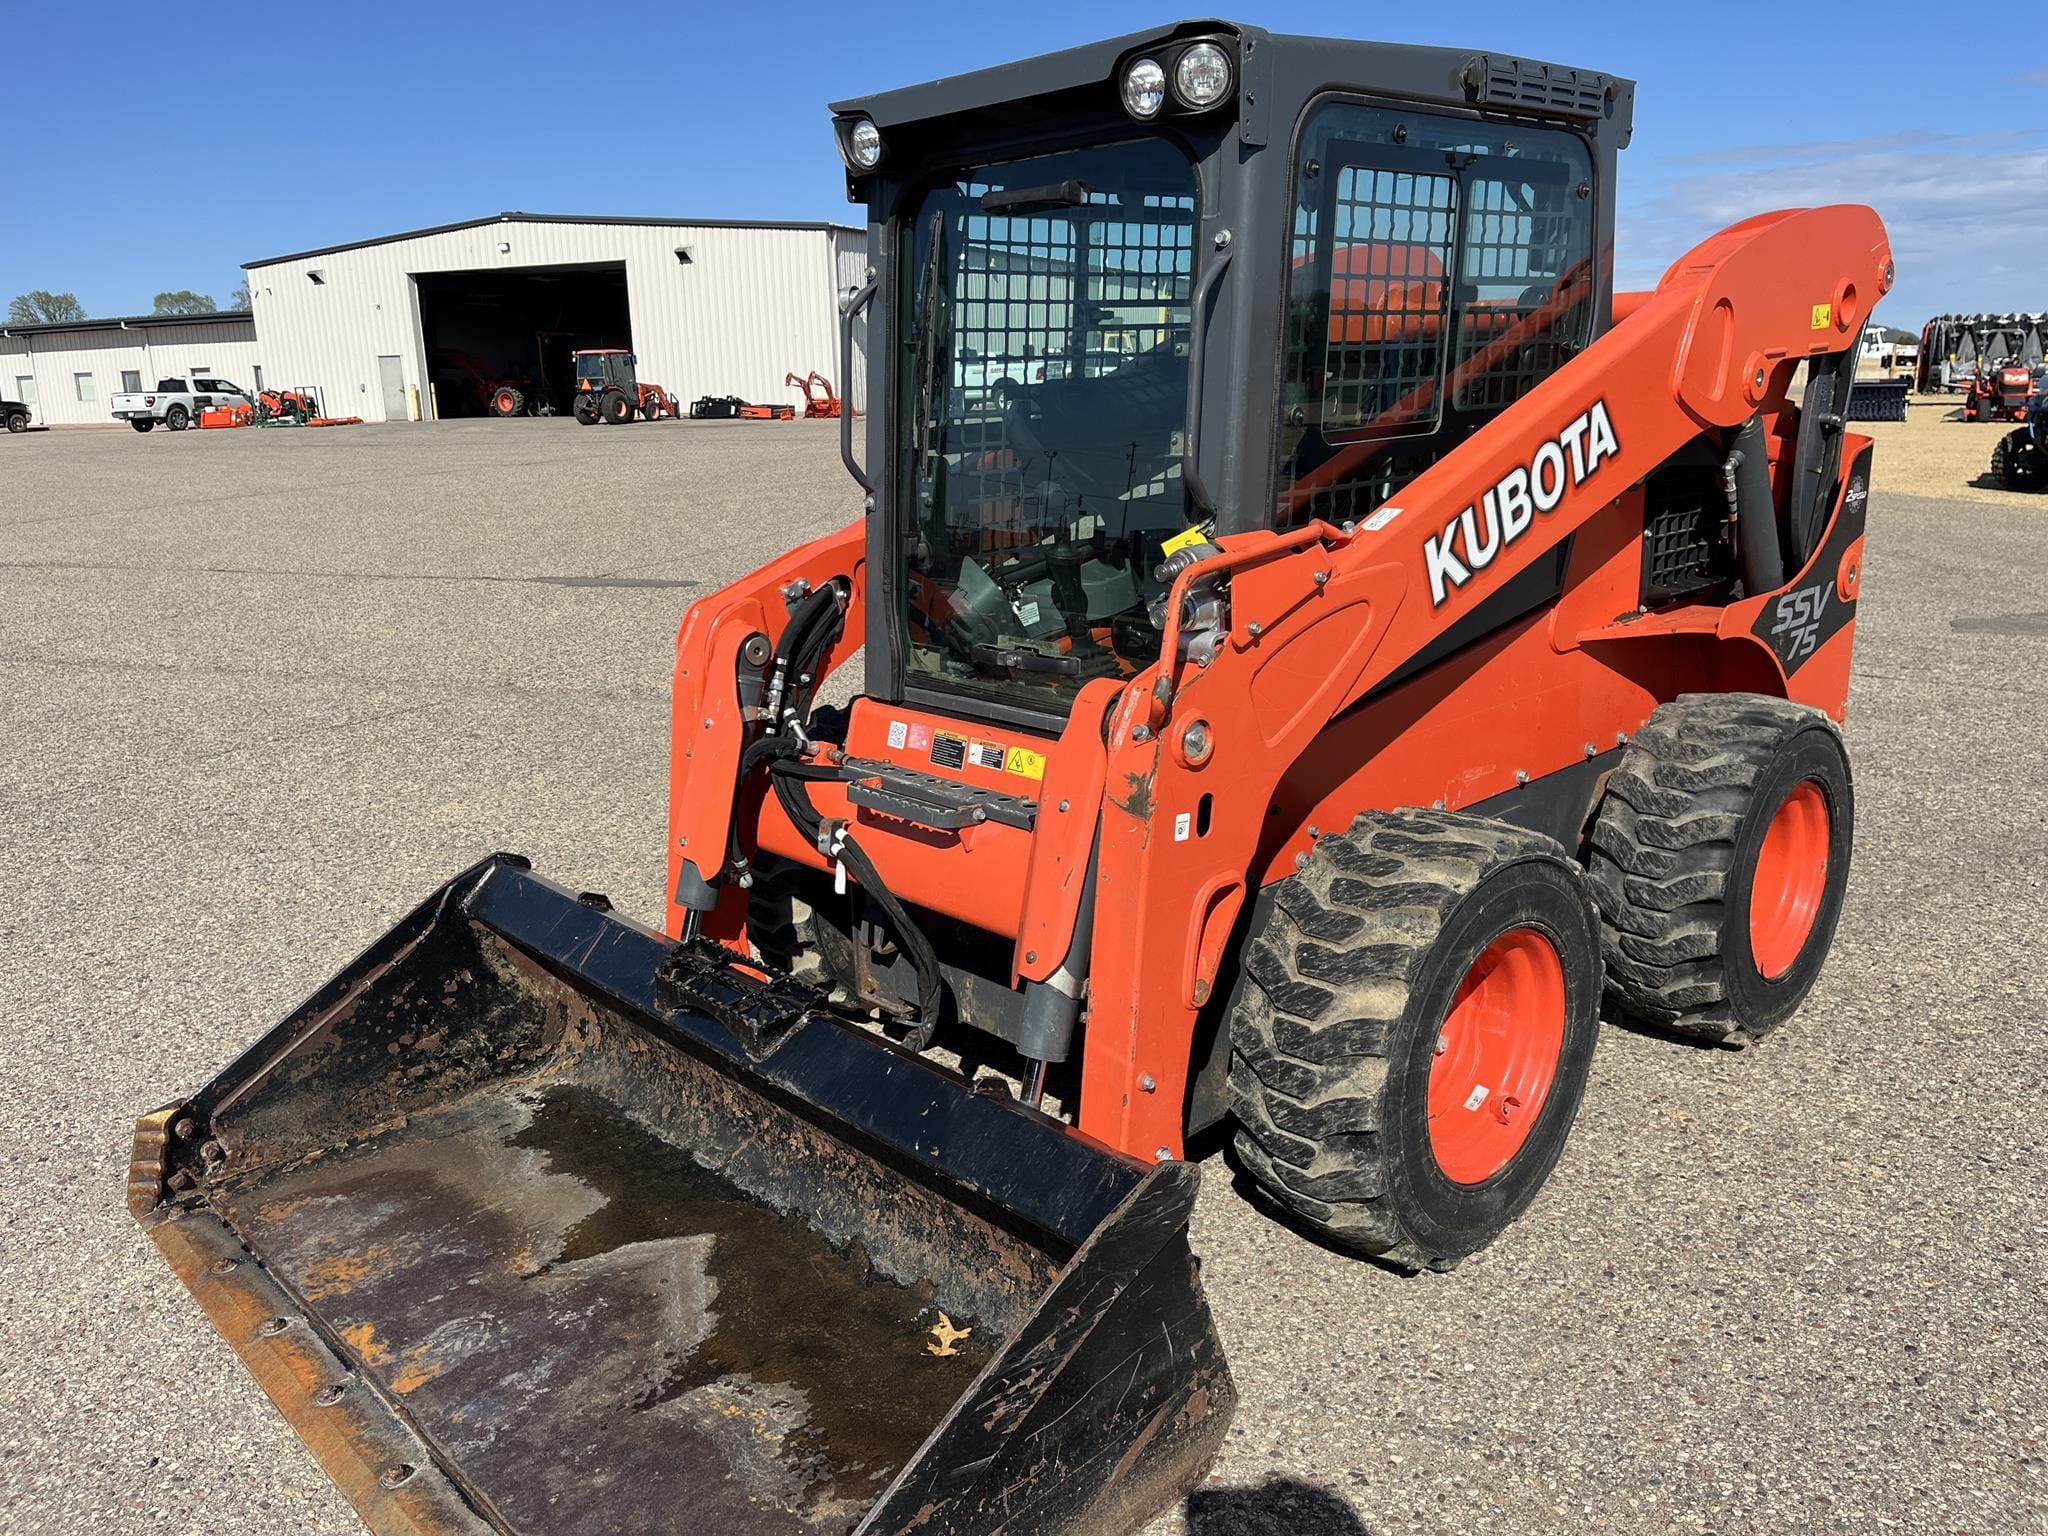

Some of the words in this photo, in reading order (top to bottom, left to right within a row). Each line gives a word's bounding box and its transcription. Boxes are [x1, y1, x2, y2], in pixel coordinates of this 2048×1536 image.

[1423, 400, 1619, 607] KUBOTA
[1771, 581, 1835, 635] SSV
[1787, 623, 1820, 661] 75
